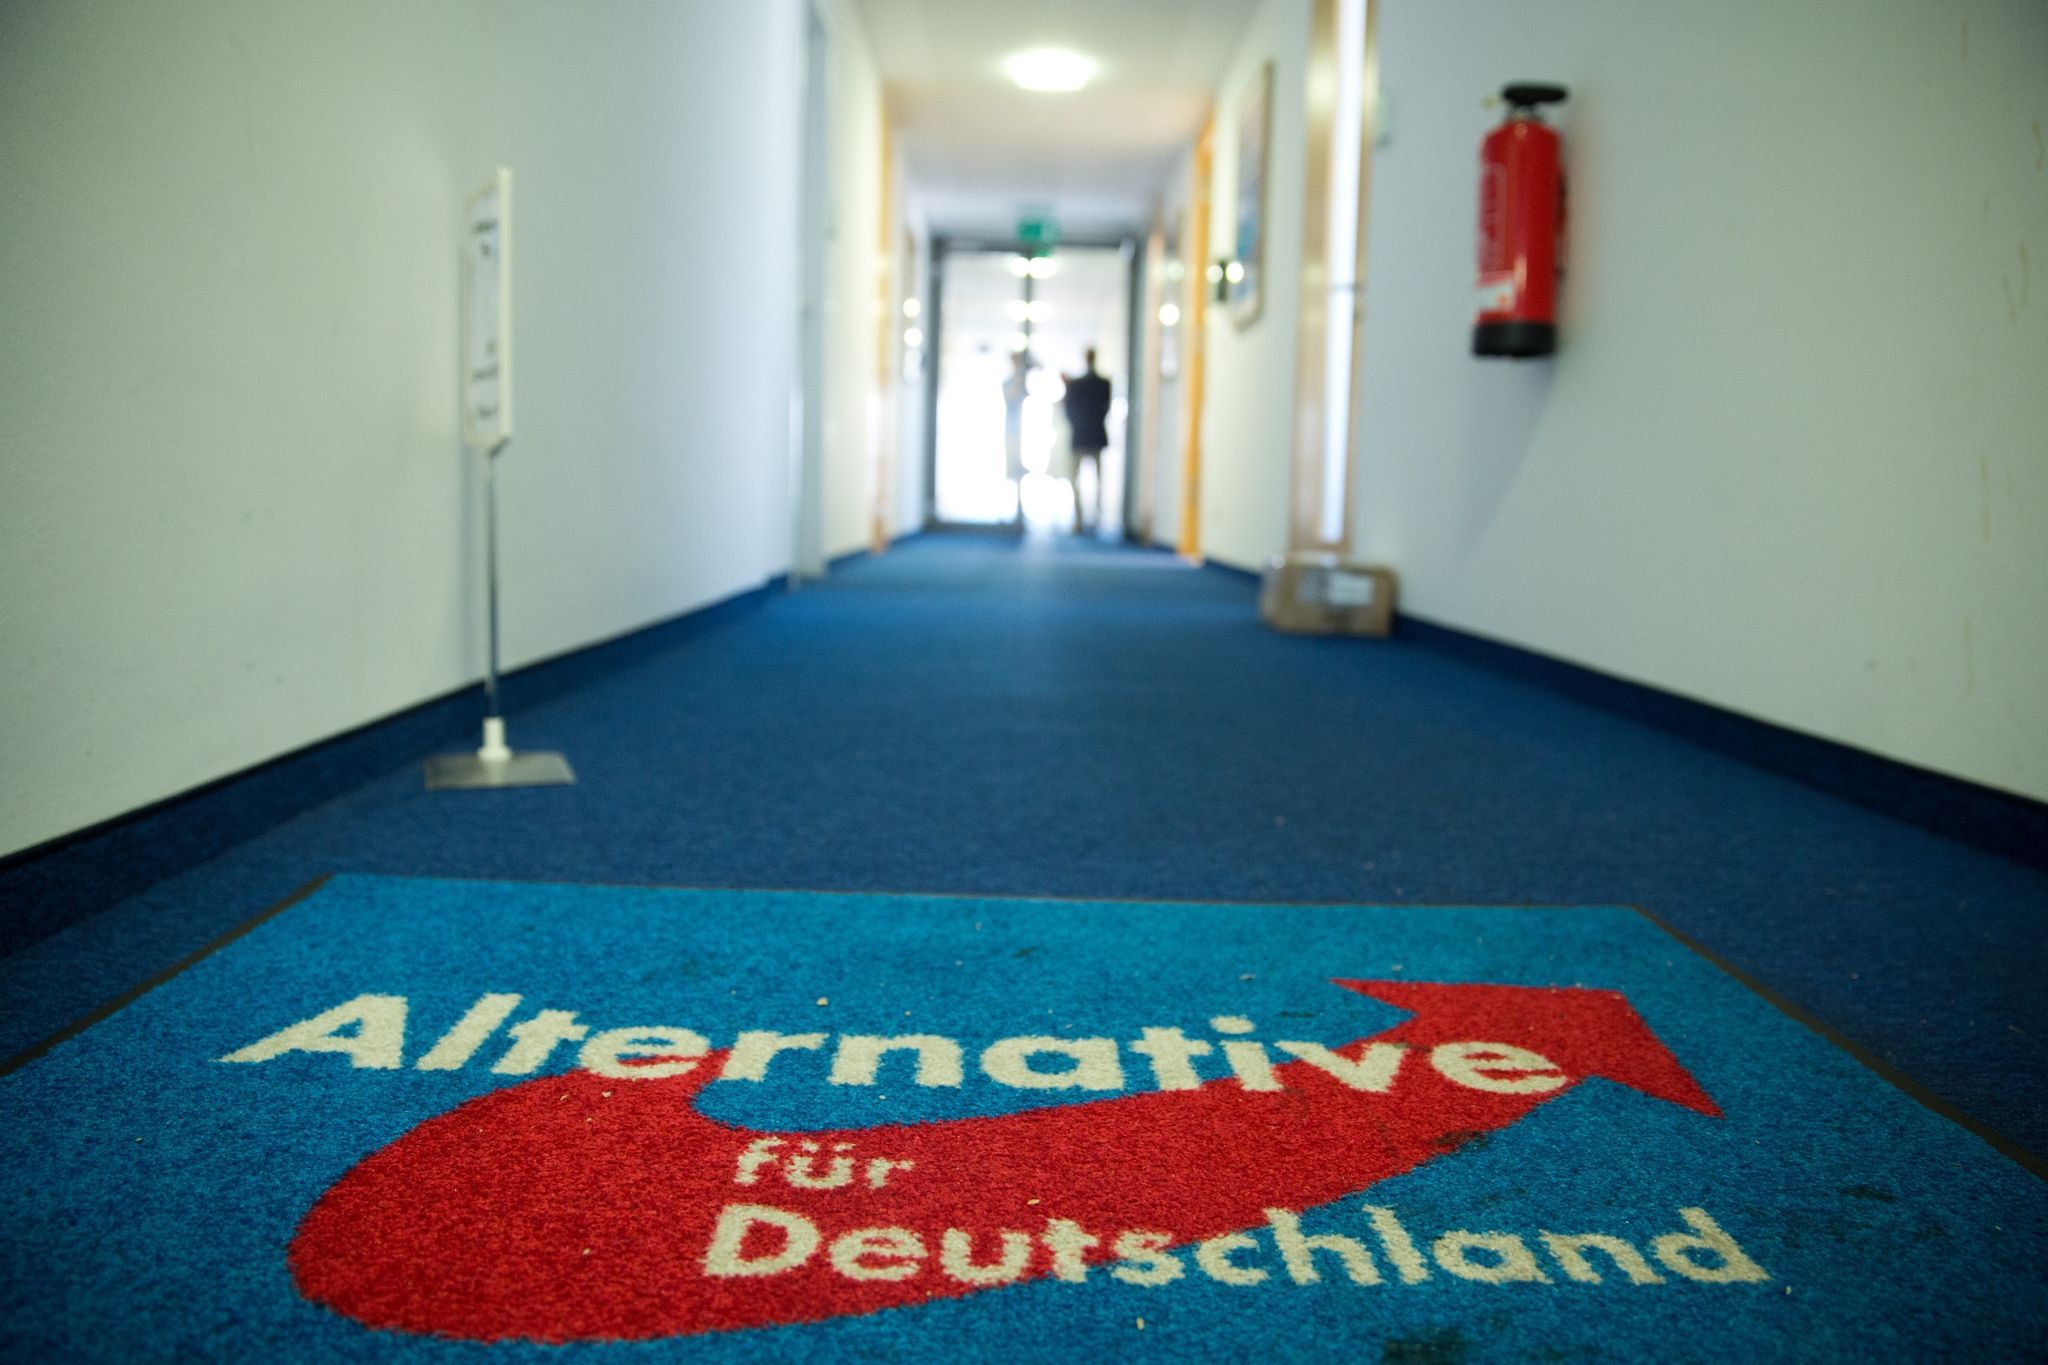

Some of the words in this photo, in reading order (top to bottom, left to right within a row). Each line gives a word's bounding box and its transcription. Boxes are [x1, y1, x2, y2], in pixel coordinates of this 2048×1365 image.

[220, 992, 1568, 1096] Alternative
[734, 1135, 916, 1191] für
[702, 1204, 1769, 1288] Deutschland
